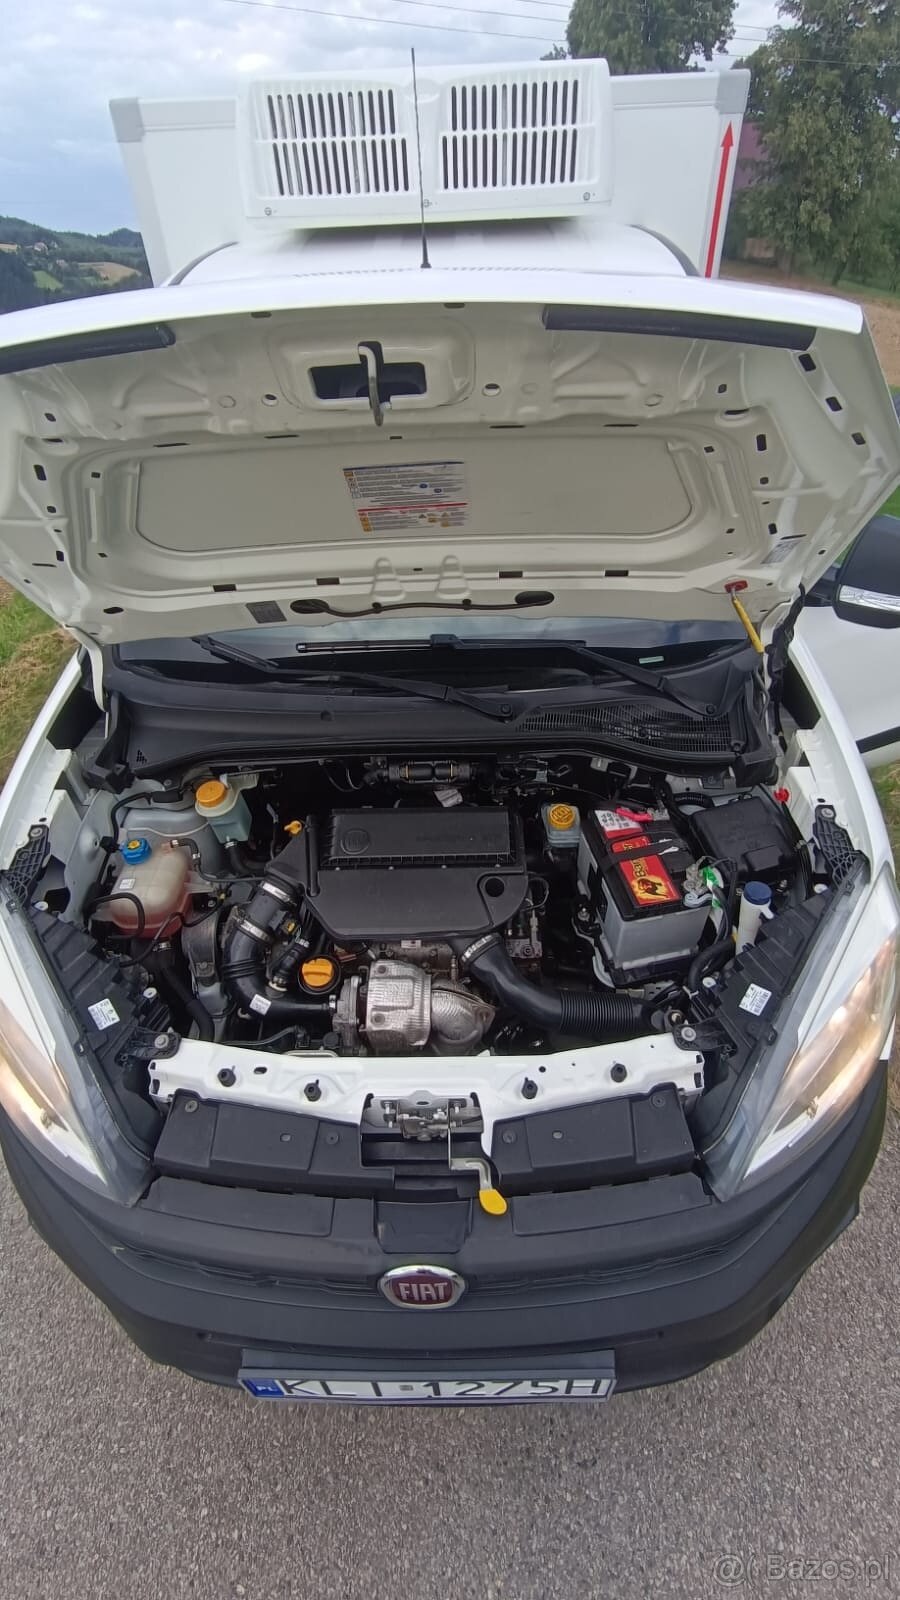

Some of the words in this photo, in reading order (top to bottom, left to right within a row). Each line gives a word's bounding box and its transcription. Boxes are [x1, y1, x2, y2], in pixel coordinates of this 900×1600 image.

[398, 1282, 448, 1301] FIAT
[277, 1379, 383, 1397] KLI
[423, 1379, 602, 1397] 1275H
